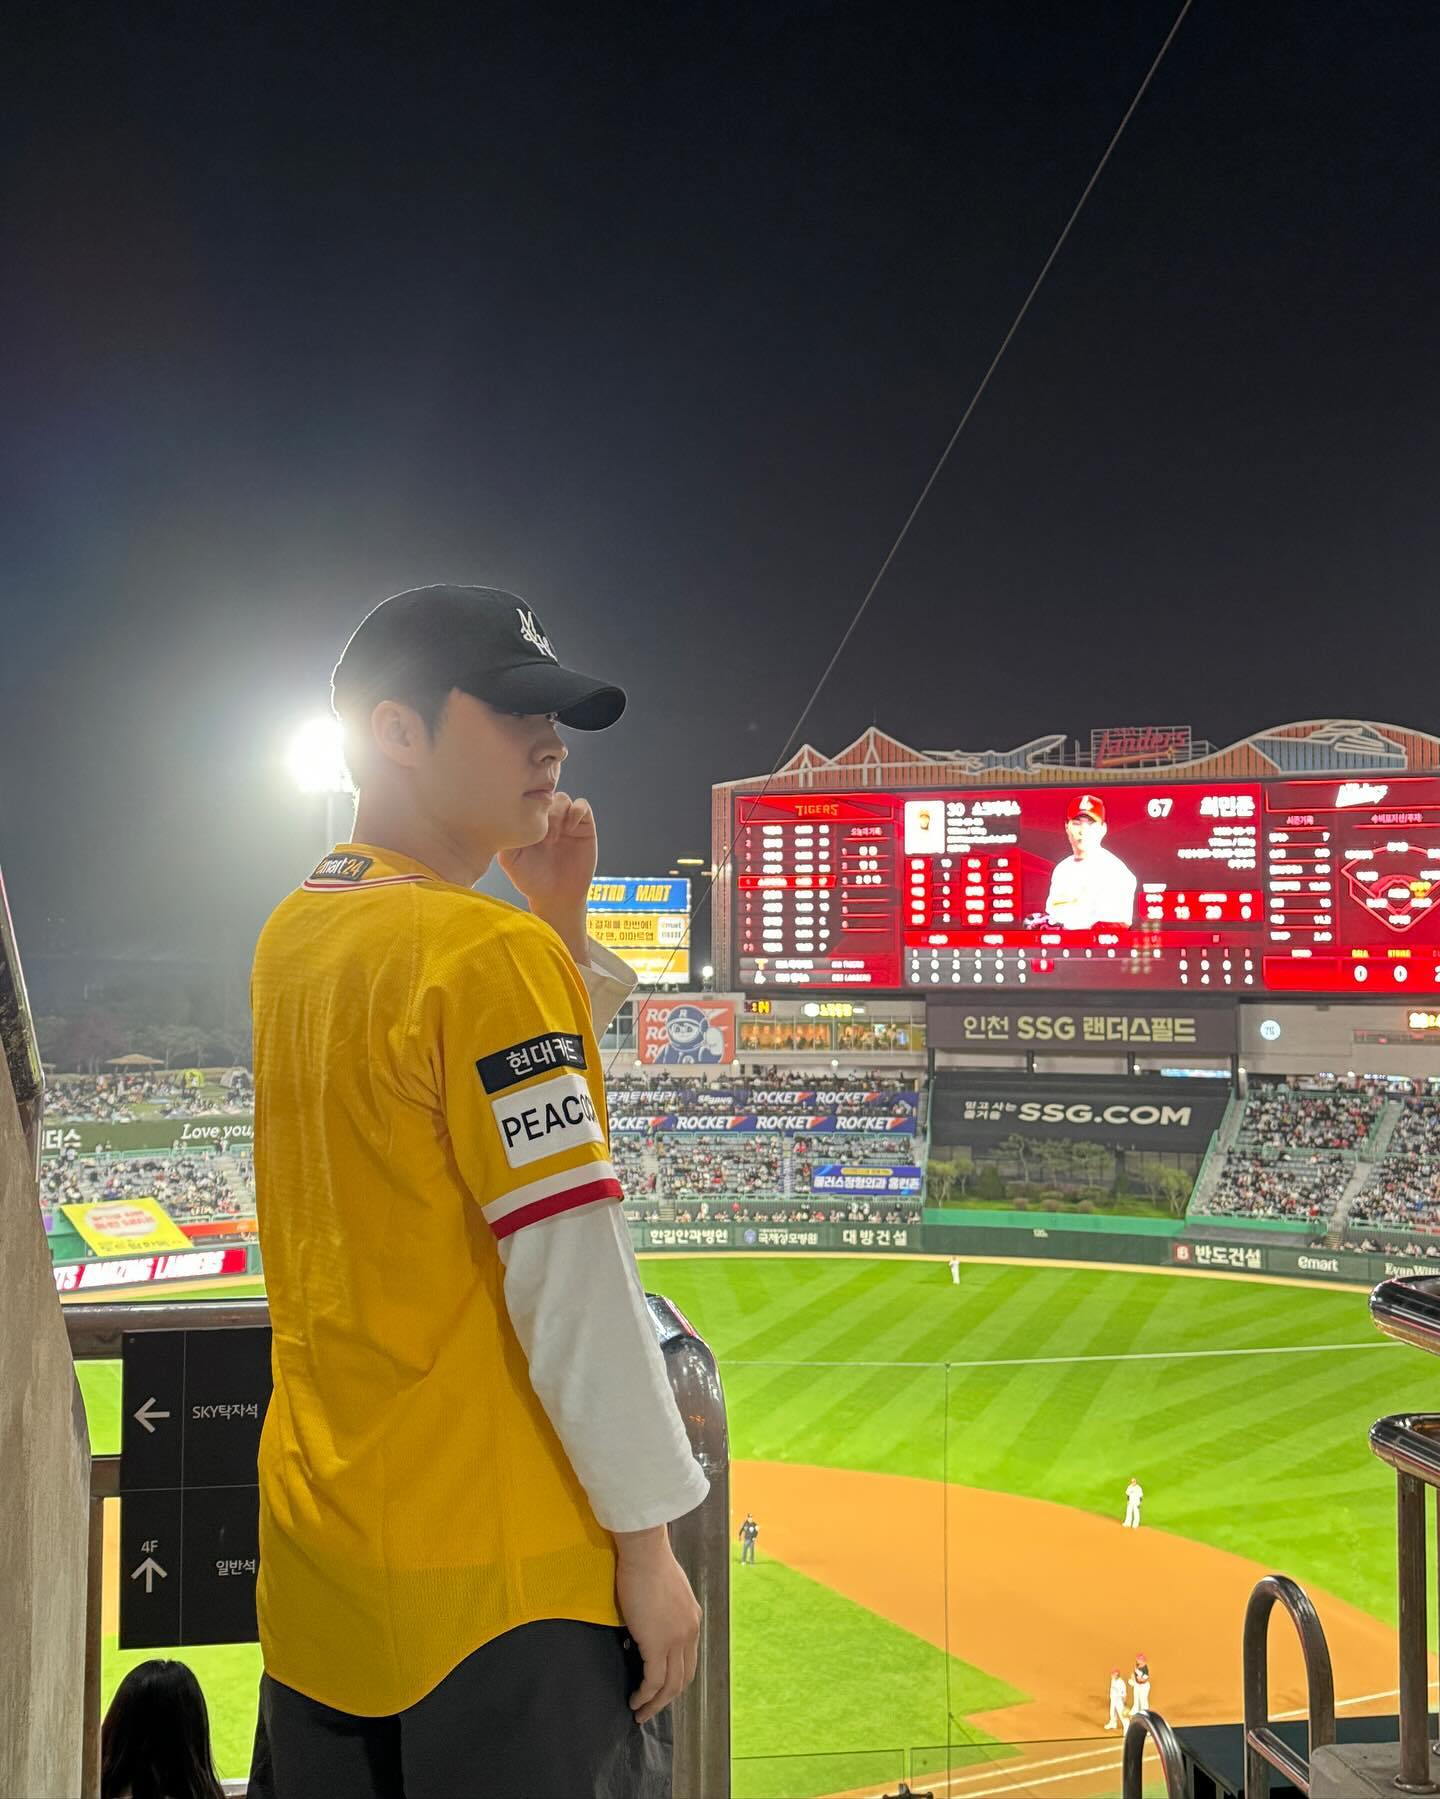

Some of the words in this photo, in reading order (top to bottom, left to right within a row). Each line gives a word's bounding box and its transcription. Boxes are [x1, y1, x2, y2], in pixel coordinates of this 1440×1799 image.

[795, 804, 838, 817] TIGERS
[1147, 798, 1173, 818] 67
[635, 885, 672, 902] MART
[1354, 965, 1368, 982] 0
[1393, 965, 1408, 982] 0
[963, 1015, 1009, 1040] 인천
[1017, 1017, 1075, 1040] SSG
[1083, 1016, 1196, 1042] 랜더스필드
[816, 1091, 868, 1105] ROCKET
[676, 1116, 733, 1130] ROCKET
[756, 1116, 813, 1130] ROCKET
[1018, 1102, 1192, 1127] SSG.COM
[181, 1123, 220, 1139] Love
[836, 1116, 893, 1131] ROCKET
[649, 1228, 728, 1245] 한길안과병원
[758, 1232, 818, 1246] 국제성모병원
[842, 1229, 908, 1246] 대방건설
[1194, 1245, 1261, 1268] 반도건설
[1297, 1256, 1339, 1272] emart
[192, 1402, 259, 1420] SKY탁자석
[141, 1541, 159, 1553] 4F
[216, 1558, 257, 1576] 일반석
